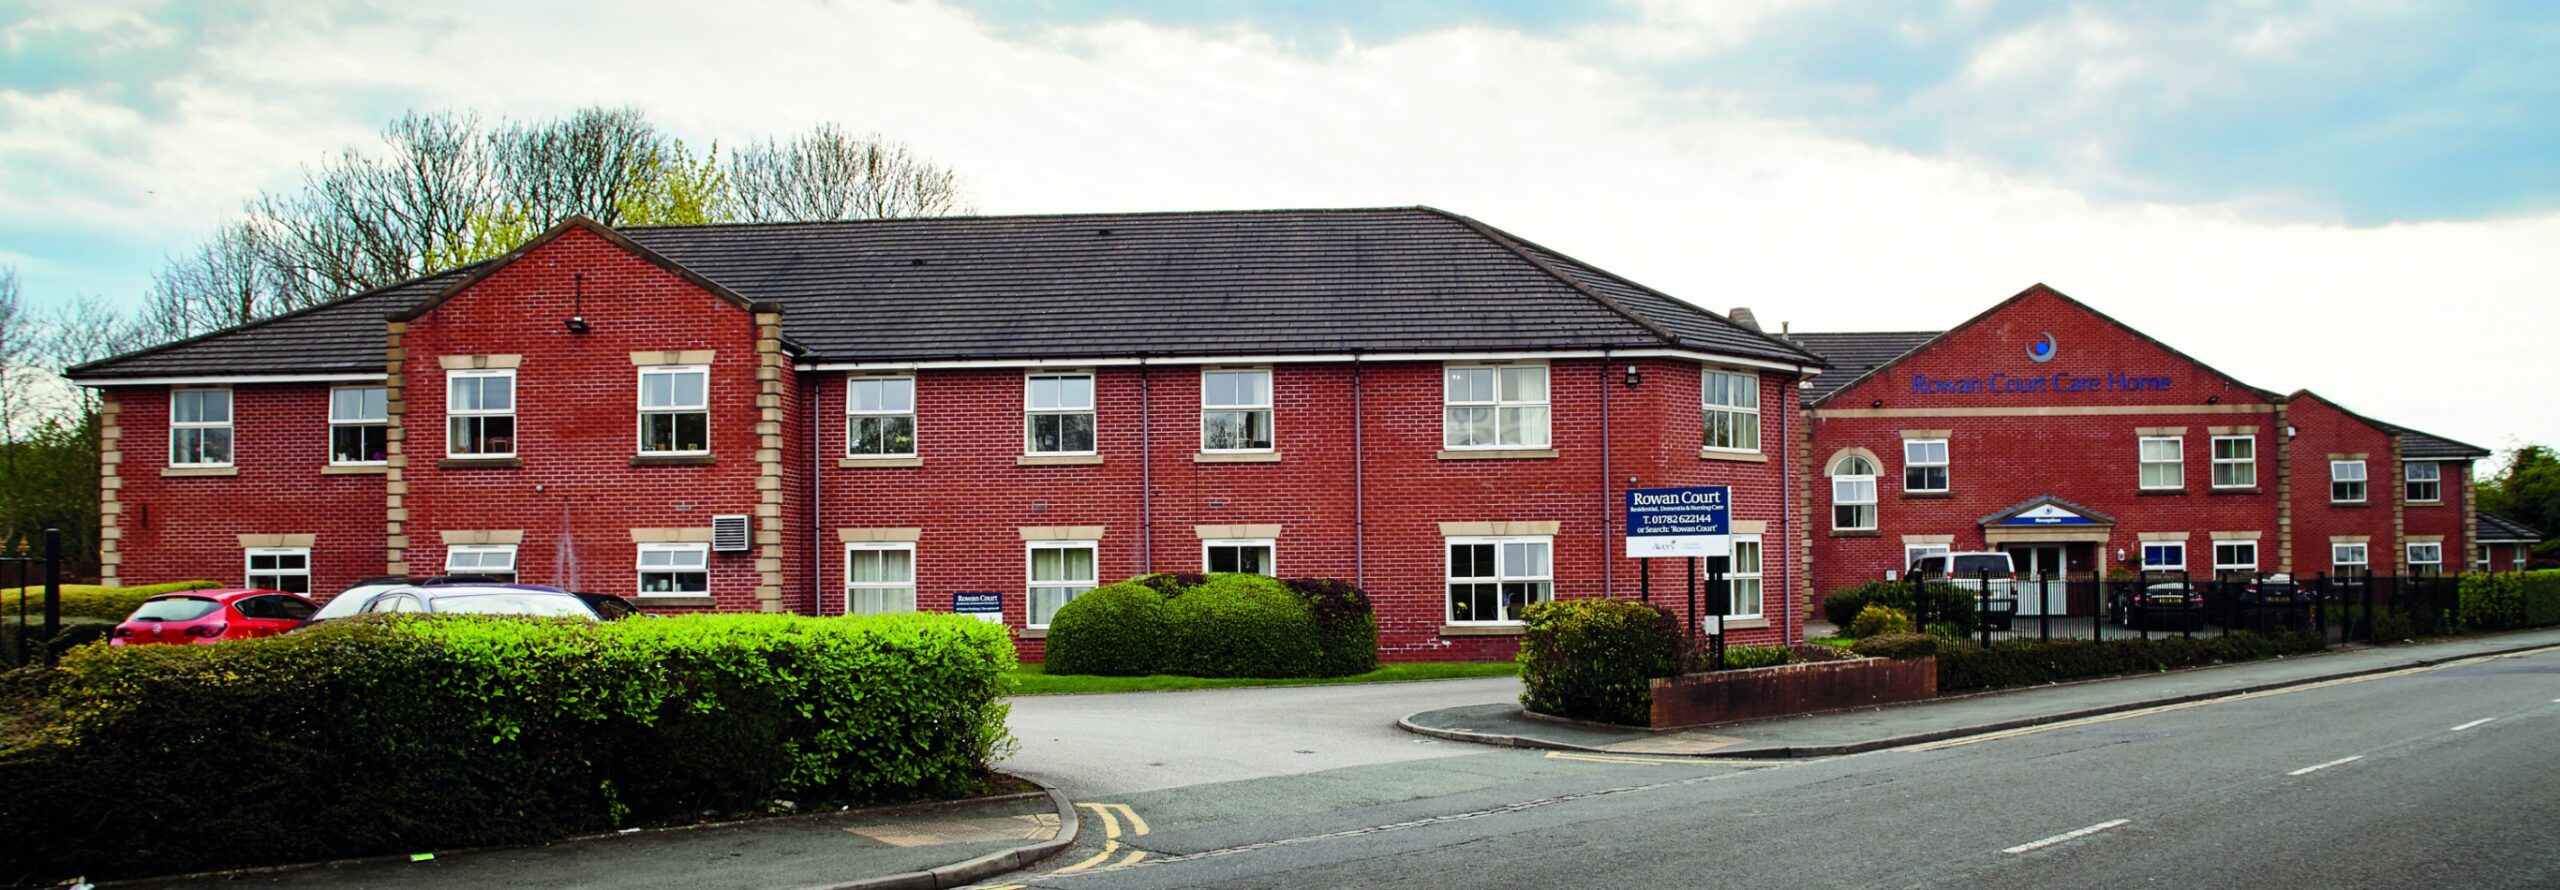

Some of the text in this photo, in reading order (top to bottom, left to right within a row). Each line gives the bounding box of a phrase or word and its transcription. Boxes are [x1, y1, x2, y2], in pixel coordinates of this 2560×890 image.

[1912, 371, 2172, 394] Rowan Court Care Home
[1634, 491, 1720, 505] Rowan Court
[1643, 514, 1711, 524] T. 01782 622144
